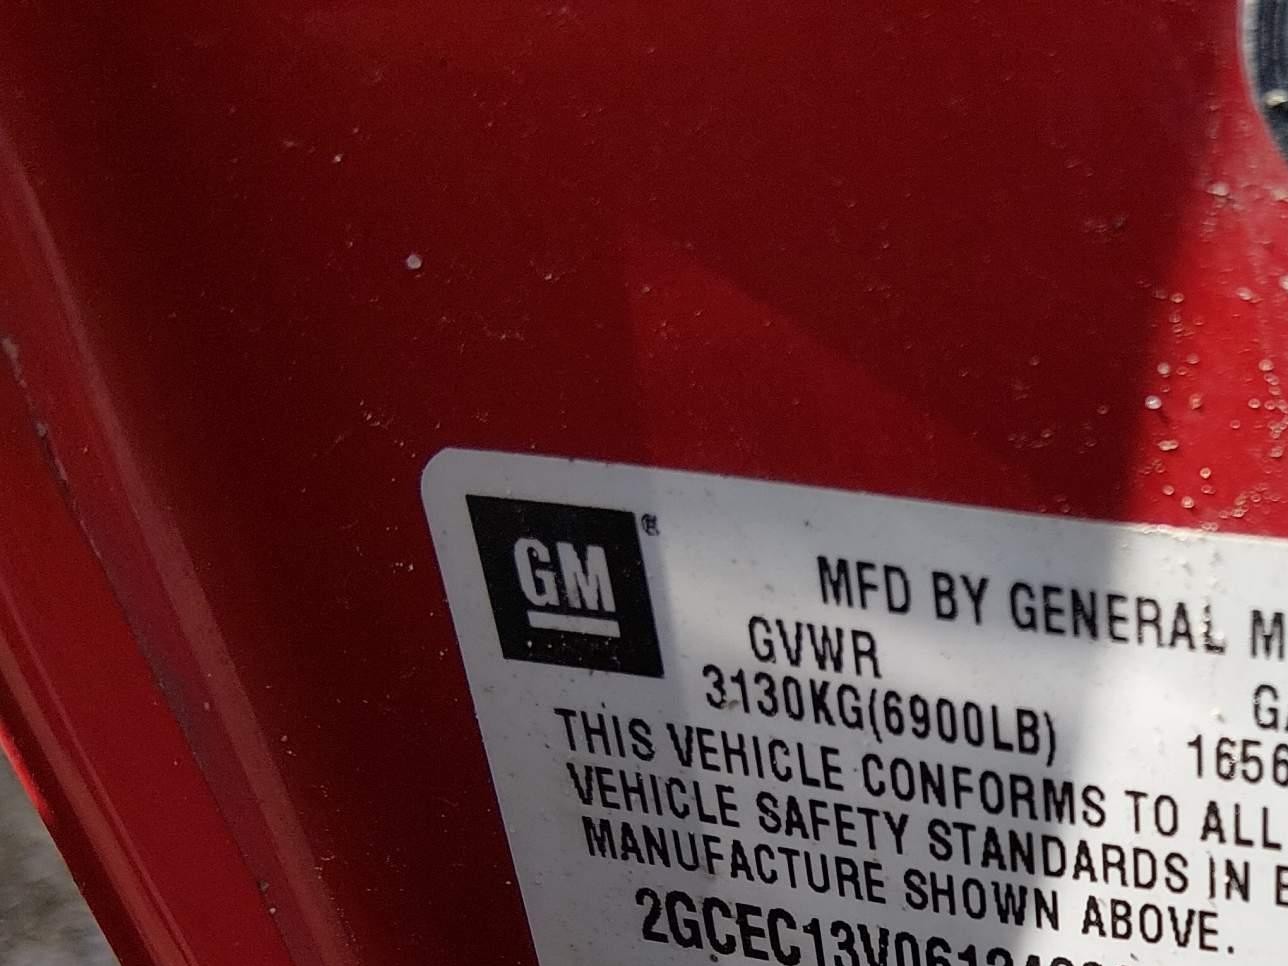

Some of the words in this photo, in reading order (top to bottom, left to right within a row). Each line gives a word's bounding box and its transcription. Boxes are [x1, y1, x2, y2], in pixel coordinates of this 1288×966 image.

[513, 536, 616, 612] GM
[817, 556, 911, 616] MFD
[932, 571, 989, 625] BY
[1011, 580, 1226, 654] GENERAL
[748, 616, 882, 678] GVWR
[703, 665, 1057, 764] 3130KG(6900LB)
[555, 708, 656, 762] THIS
[668, 723, 844, 791] VEHICLE
[862, 755, 1108, 828] CONFORMS
[1126, 791, 1180, 837] TO
[1200, 803, 1282, 852] ALL
[567, 763, 738, 829] VEHICLE
[757, 791, 909, 856] SAFETY
[928, 820, 1189, 894] STANDARDS
[1209, 855, 1250, 903] IN
[582, 816, 887, 905] MANUFACTURE
[904, 873, 1060, 932] SHOWN
[1081, 899, 1235, 955] ABOVE.
